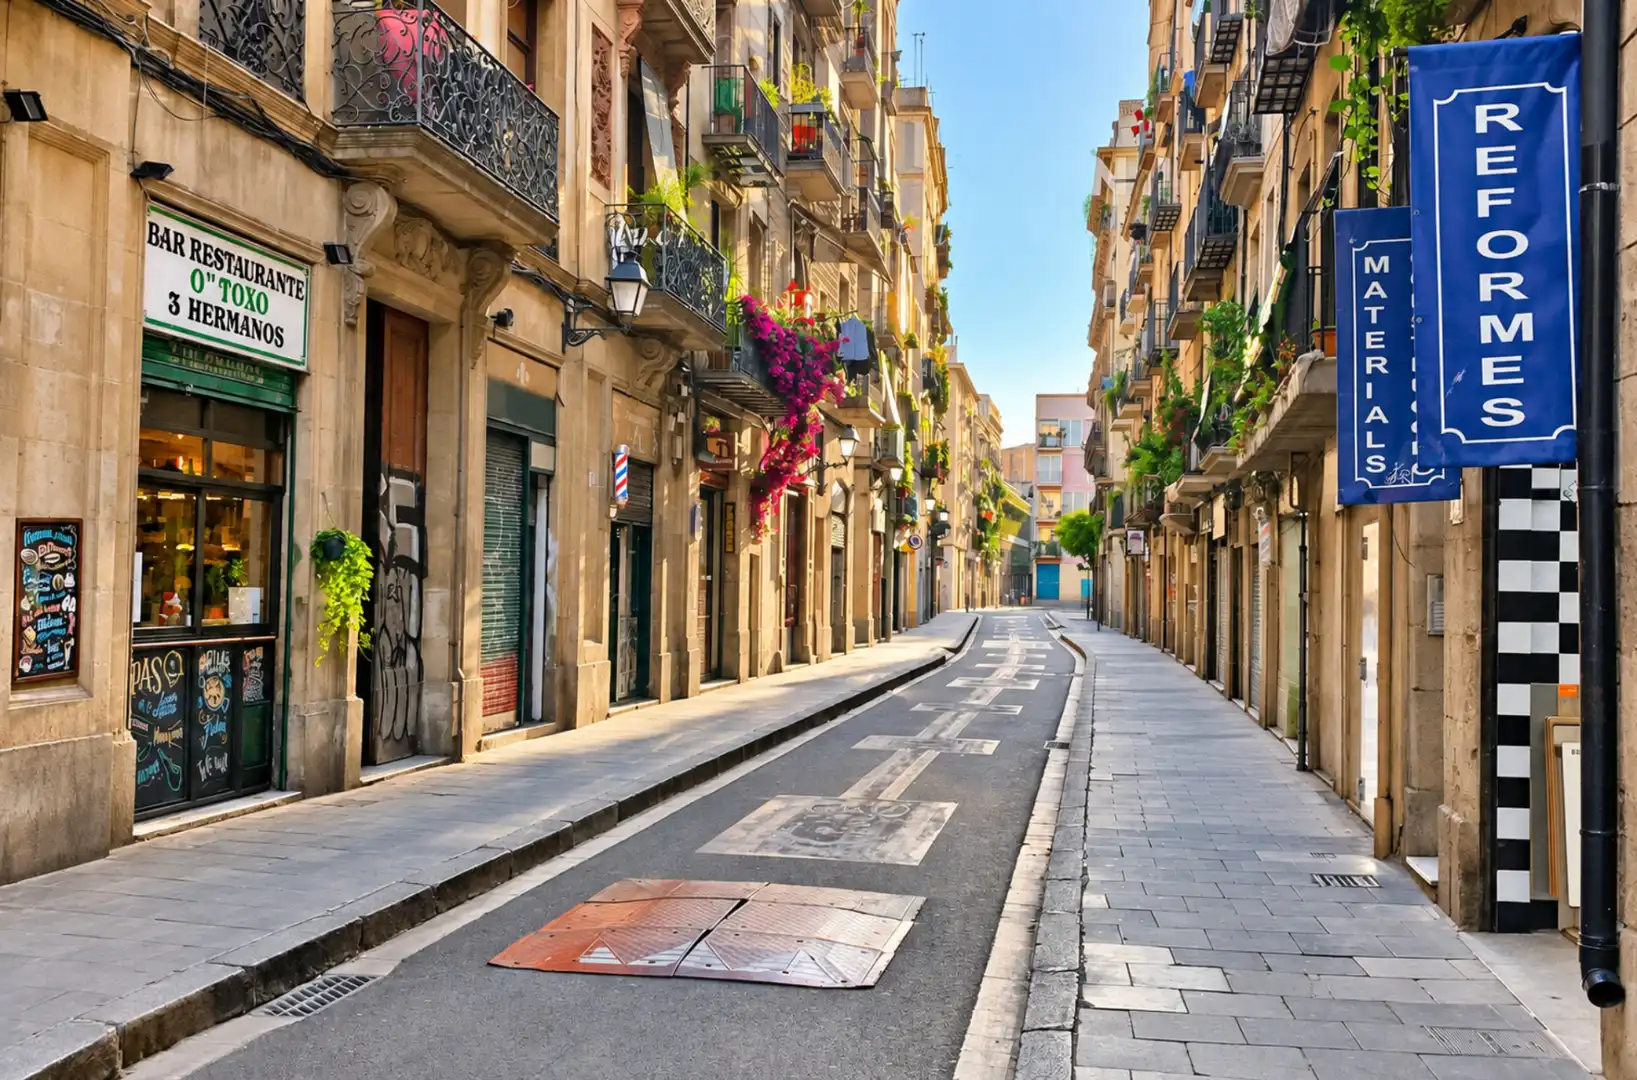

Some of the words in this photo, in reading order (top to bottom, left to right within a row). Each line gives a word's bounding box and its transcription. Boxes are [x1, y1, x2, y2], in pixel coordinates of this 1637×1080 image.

[146, 220, 186, 258] BAR
[189, 236, 305, 302] RESTAURANTE
[218, 276, 270, 316] TOXO
[1475, 102, 1534, 428] REFORMES
[167, 290, 181, 317] 3
[187, 297, 285, 349] HERMANOS
[1362, 255, 1390, 474] MATERIALS
